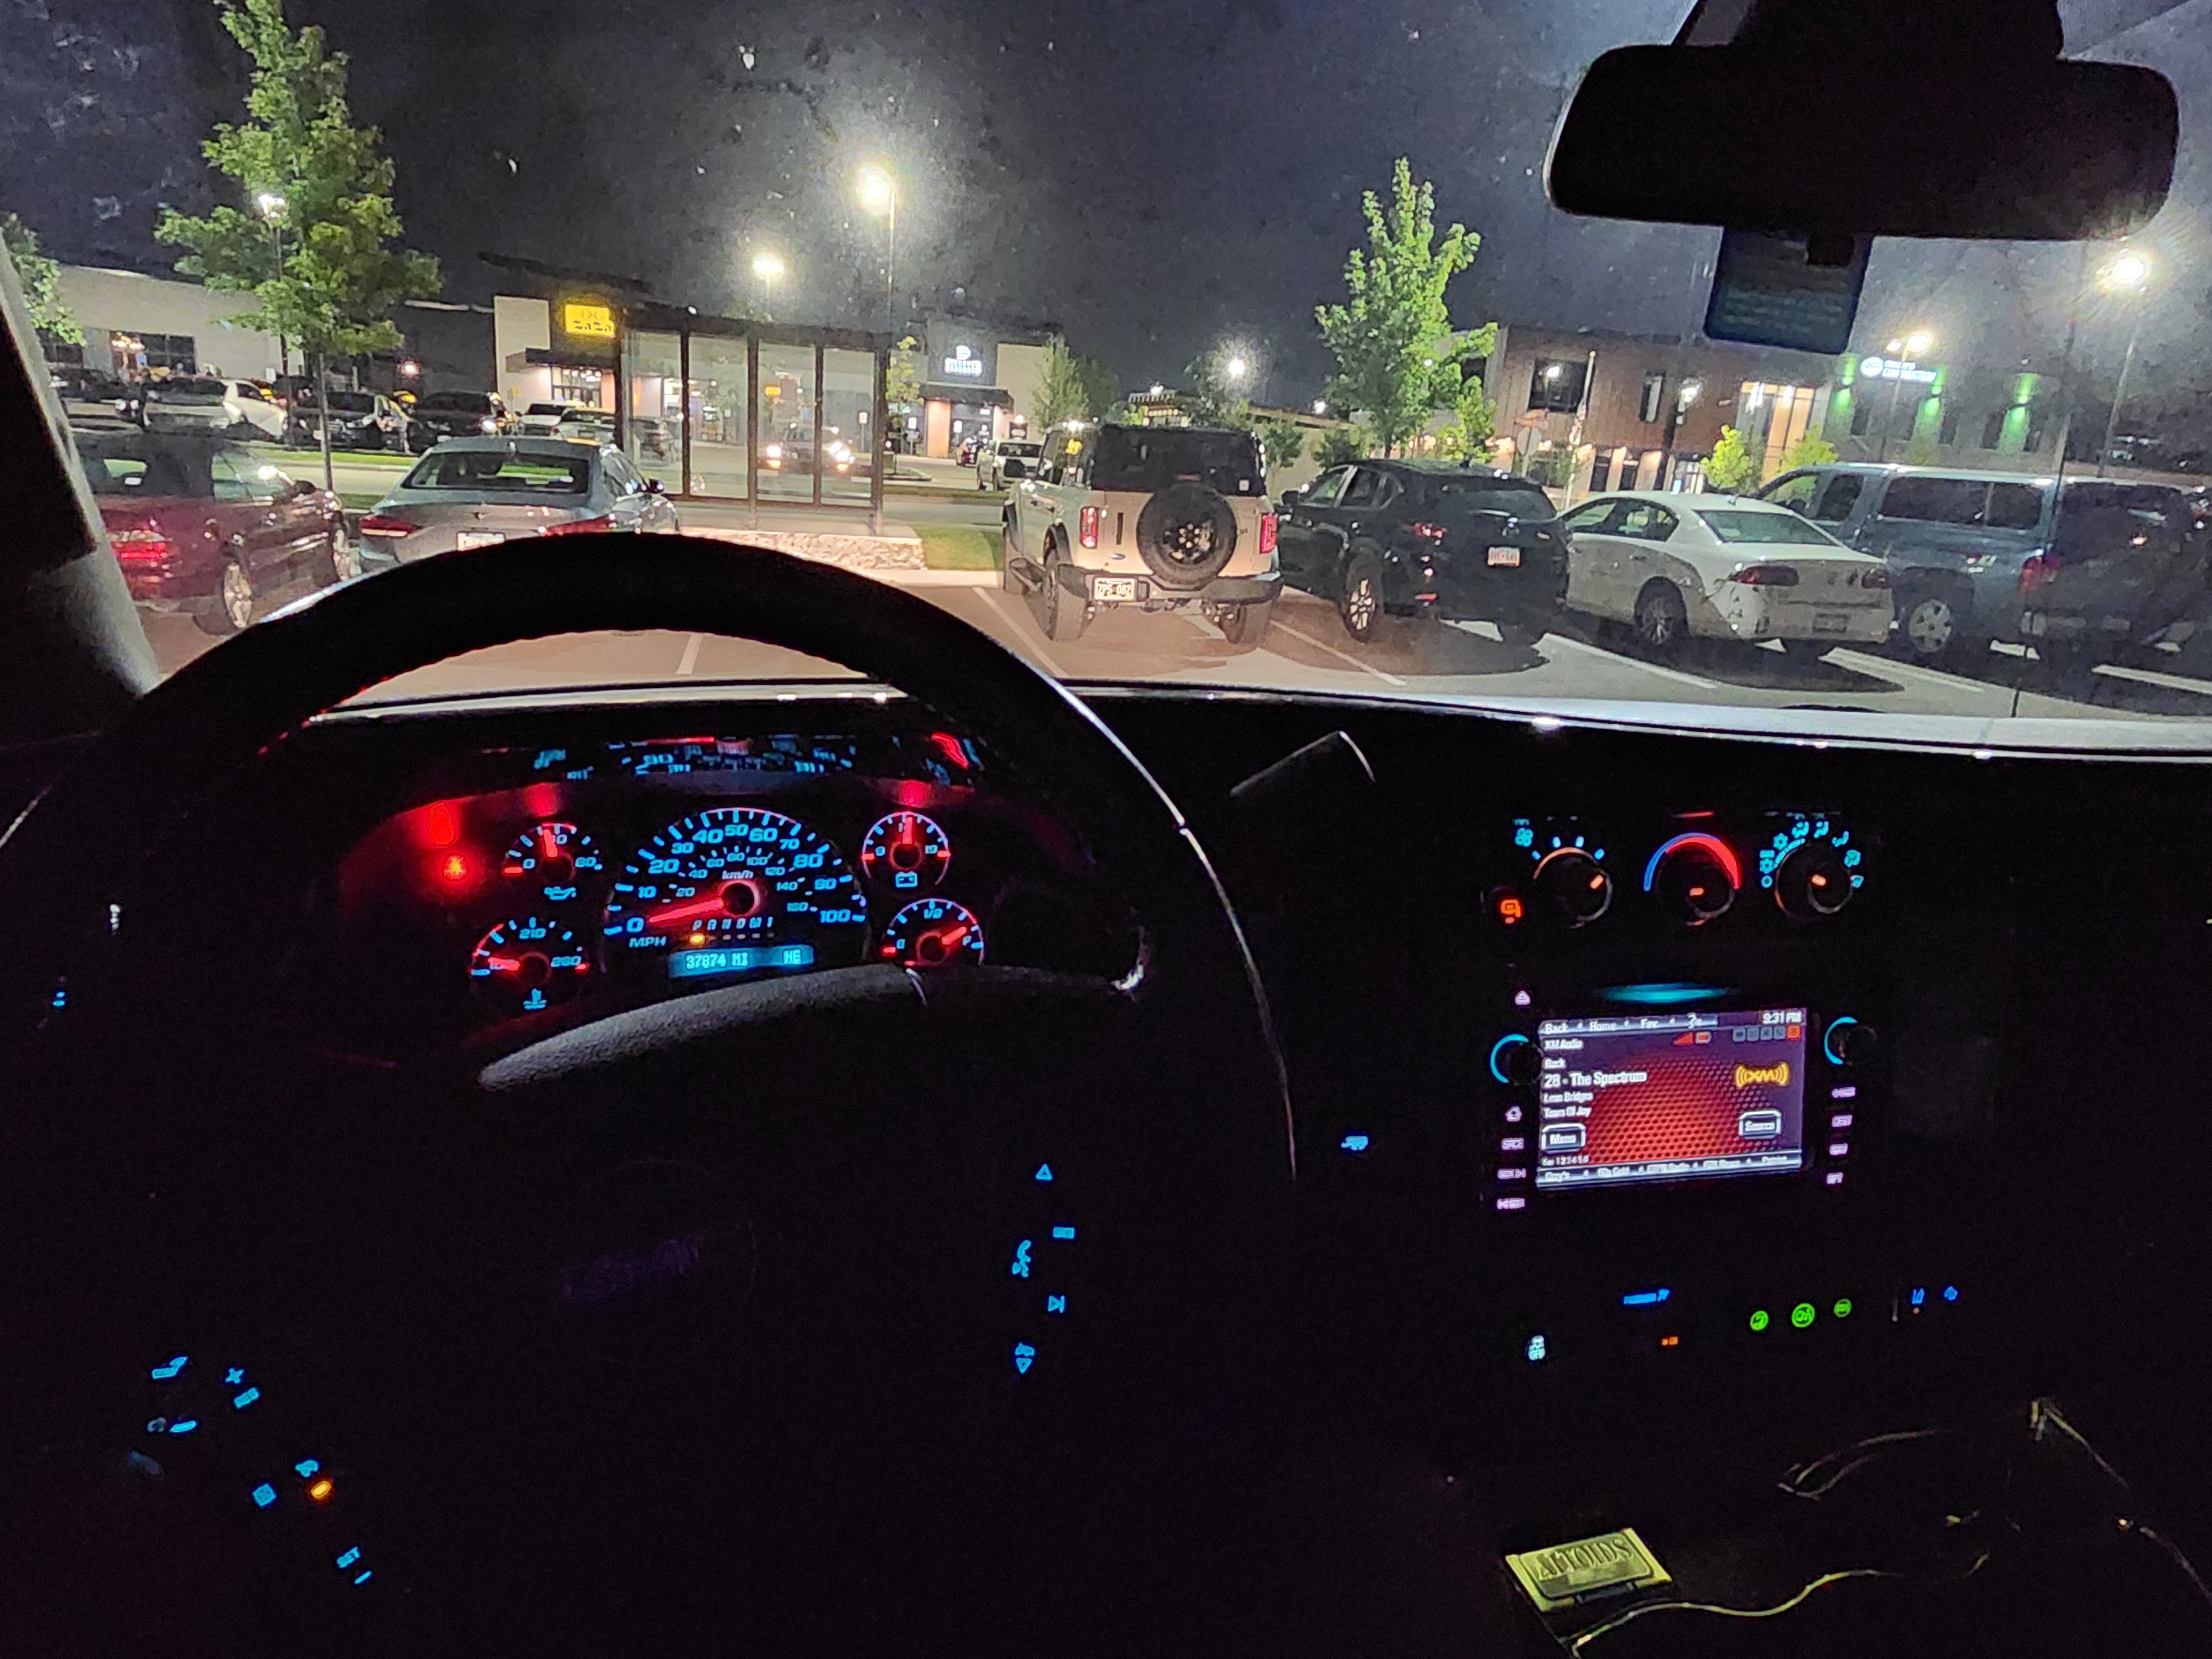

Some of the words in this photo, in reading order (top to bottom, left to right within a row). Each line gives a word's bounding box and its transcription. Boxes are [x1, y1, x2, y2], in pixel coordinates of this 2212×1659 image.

[692, 829, 723, 843] 40
[725, 824, 749, 837] 50
[749, 828, 778, 842] 60
[671, 842, 694, 854] 30
[779, 838, 800, 850] 70
[523, 858, 536, 869] 0
[648, 859, 680, 874] 20
[747, 857, 768, 866] 100
[793, 854, 824, 868] 80
[688, 869, 708, 879] 40
[722, 869, 754, 880] km/h
[776, 881, 799, 891] 140
[814, 878, 837, 890] 90
[638, 886, 657, 899] 10
[675, 887, 696, 897] 20
[820, 909, 851, 924] 100
[626, 917, 644, 933] 0
[692, 920, 703, 931] P
[519, 928, 546, 940] 210
[628, 936, 667, 948] MPH
[686, 953, 727, 969] 37874
[731, 951, 749, 967] MI
[782, 948, 802, 966] NE
[1545, 1023, 1569, 1035] Back
[1589, 1021, 1617, 1032] Home
[1543, 1073, 1561, 1088] 28
[1569, 1072, 1592, 1087] The
[1593, 1070, 1648, 1087] Spectrum
